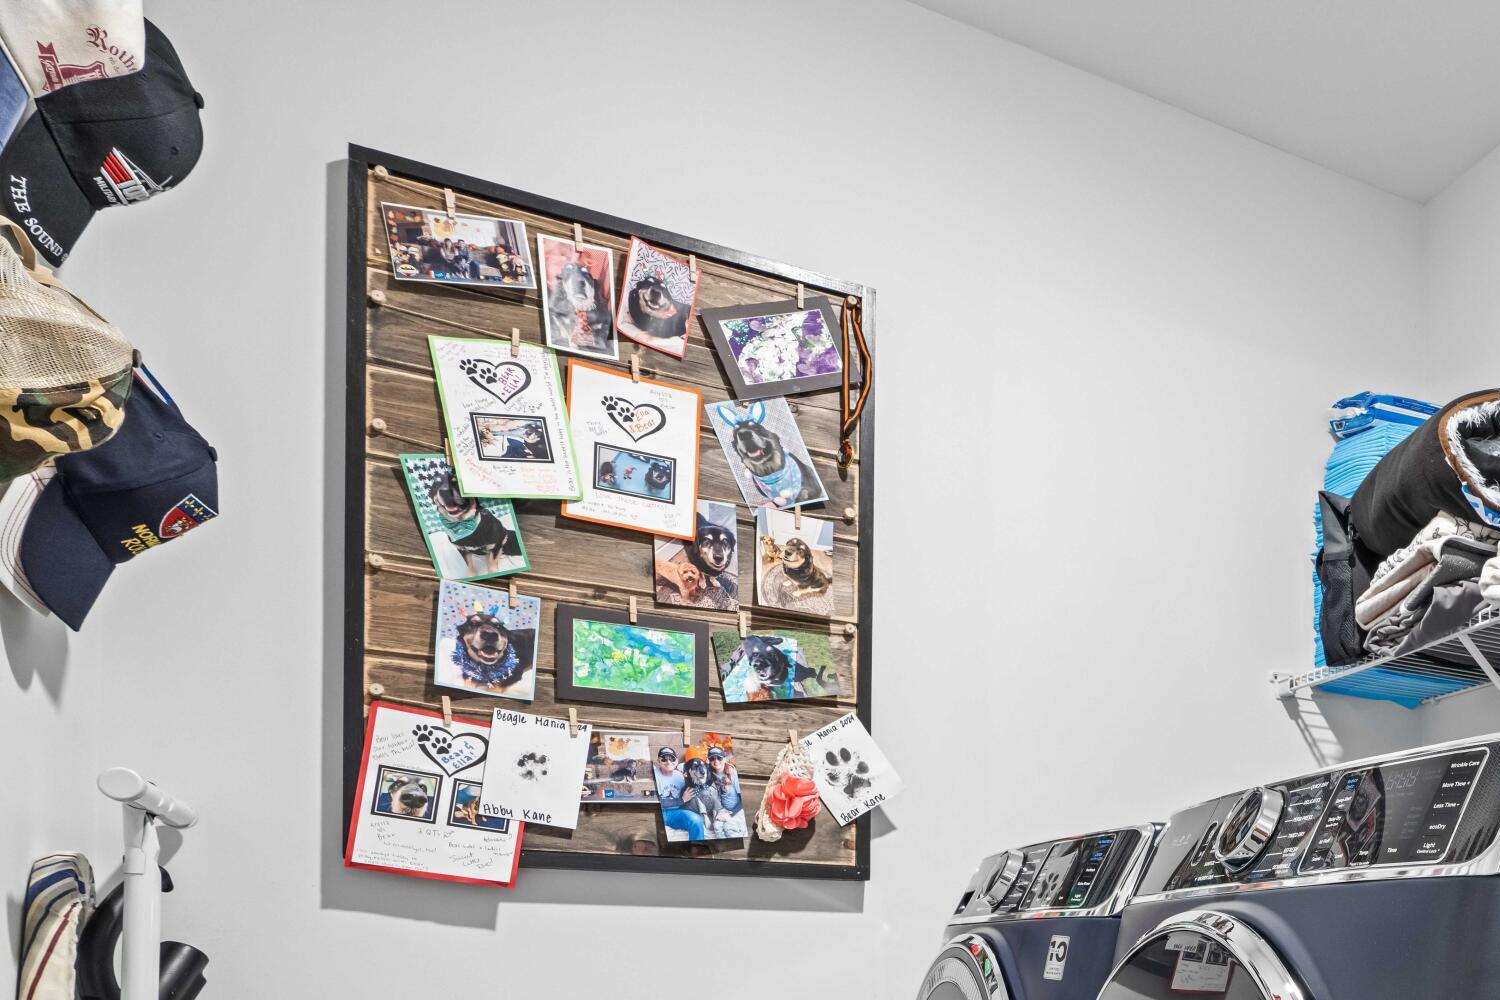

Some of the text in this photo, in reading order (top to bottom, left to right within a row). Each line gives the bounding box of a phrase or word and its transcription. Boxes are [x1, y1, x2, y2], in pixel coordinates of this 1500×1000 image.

[10, 174, 63, 257] THE SOUND
[496, 710, 527, 726] Beagle
[535, 717, 566, 730] Mania
[816, 725, 838, 740] Mania
[440, 749, 464, 764] Bear
[483, 803, 552, 823] Abby Kane
[840, 793, 886, 823] Bear Kane
[1049, 940, 1068, 963] 10
